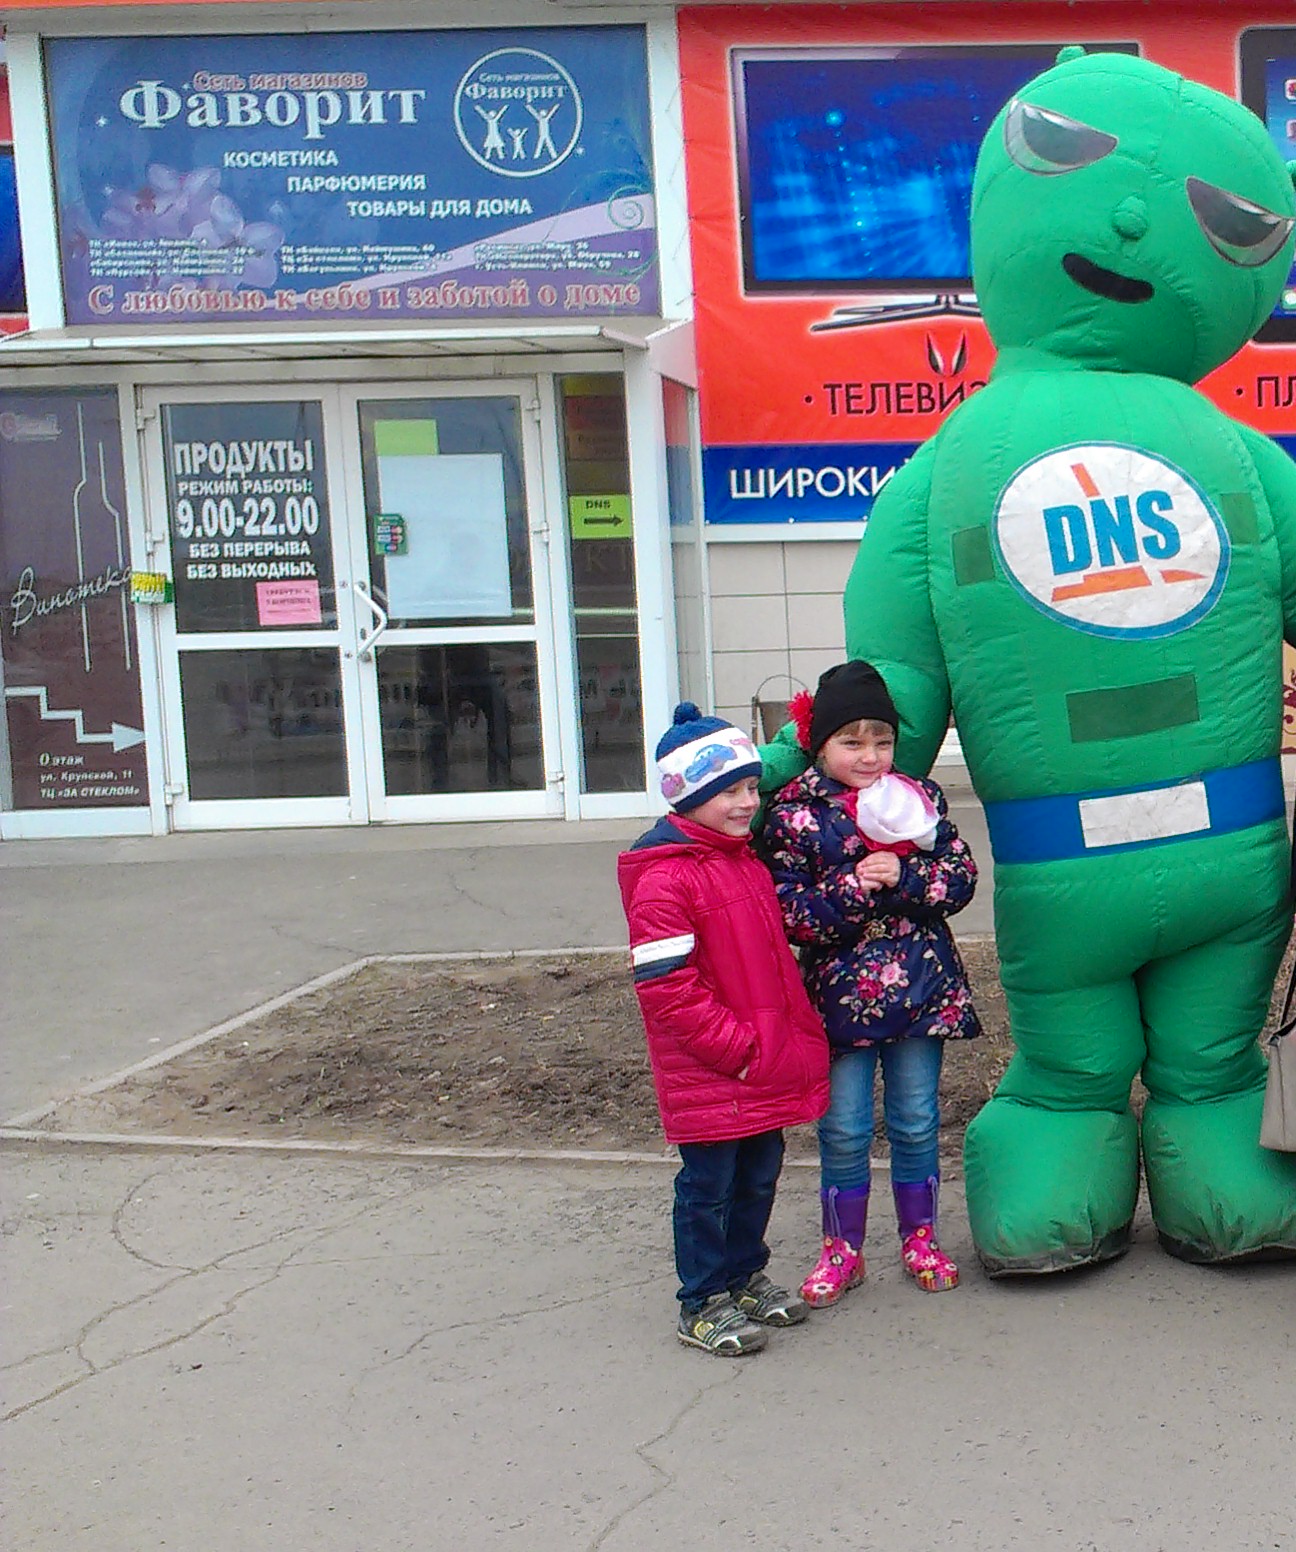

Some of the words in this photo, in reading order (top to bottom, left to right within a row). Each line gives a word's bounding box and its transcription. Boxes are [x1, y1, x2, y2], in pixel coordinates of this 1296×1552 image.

[194, 71, 246, 91] Сеть
[249, 71, 368, 91] магазинов
[465, 82, 567, 103] Фаворит
[119, 79, 427, 139] Фаворит
[223, 150, 339, 168] КОСМЕТИКА
[287, 174, 427, 194] ПАРФЮМЕРИЯ
[347, 200, 425, 217] ТОВАРЫ
[429, 200, 471, 219] ДЛЯ
[475, 199, 533, 218] ДОМА
[88, 285, 115, 314] С
[122, 283, 267, 313] любовью
[274, 288, 298, 311] к
[304, 281, 371, 312] себе
[378, 287, 400, 309] и
[406, 278, 531, 311] заботой
[537, 285, 557, 307] о
[563, 282, 641, 311] доме
[174, 440, 314, 478] ПРОДУКТЫ
[178, 480, 239, 497] РЕЖИМ
[242, 479, 313, 495] РАБОТЫ:
[730, 460, 905, 499] ШИРОКИ
[585, 499, 611, 509] DNS
[177, 496, 320, 538] 9.00-22.00
[1043, 490, 1182, 576] DNS
[189, 543, 220, 559] БЕЗ
[223, 540, 311, 557] ПЕРЕРЫВА
[187, 563, 218, 580] БЕЗ
[221, 561, 317, 579] ВЫХОДНЫХ
[11, 566, 132, 636] Винотека
[52, 755, 84, 766] этаж
[40, 772, 57, 783] ул.
[41, 788, 56, 799] ТЦ
